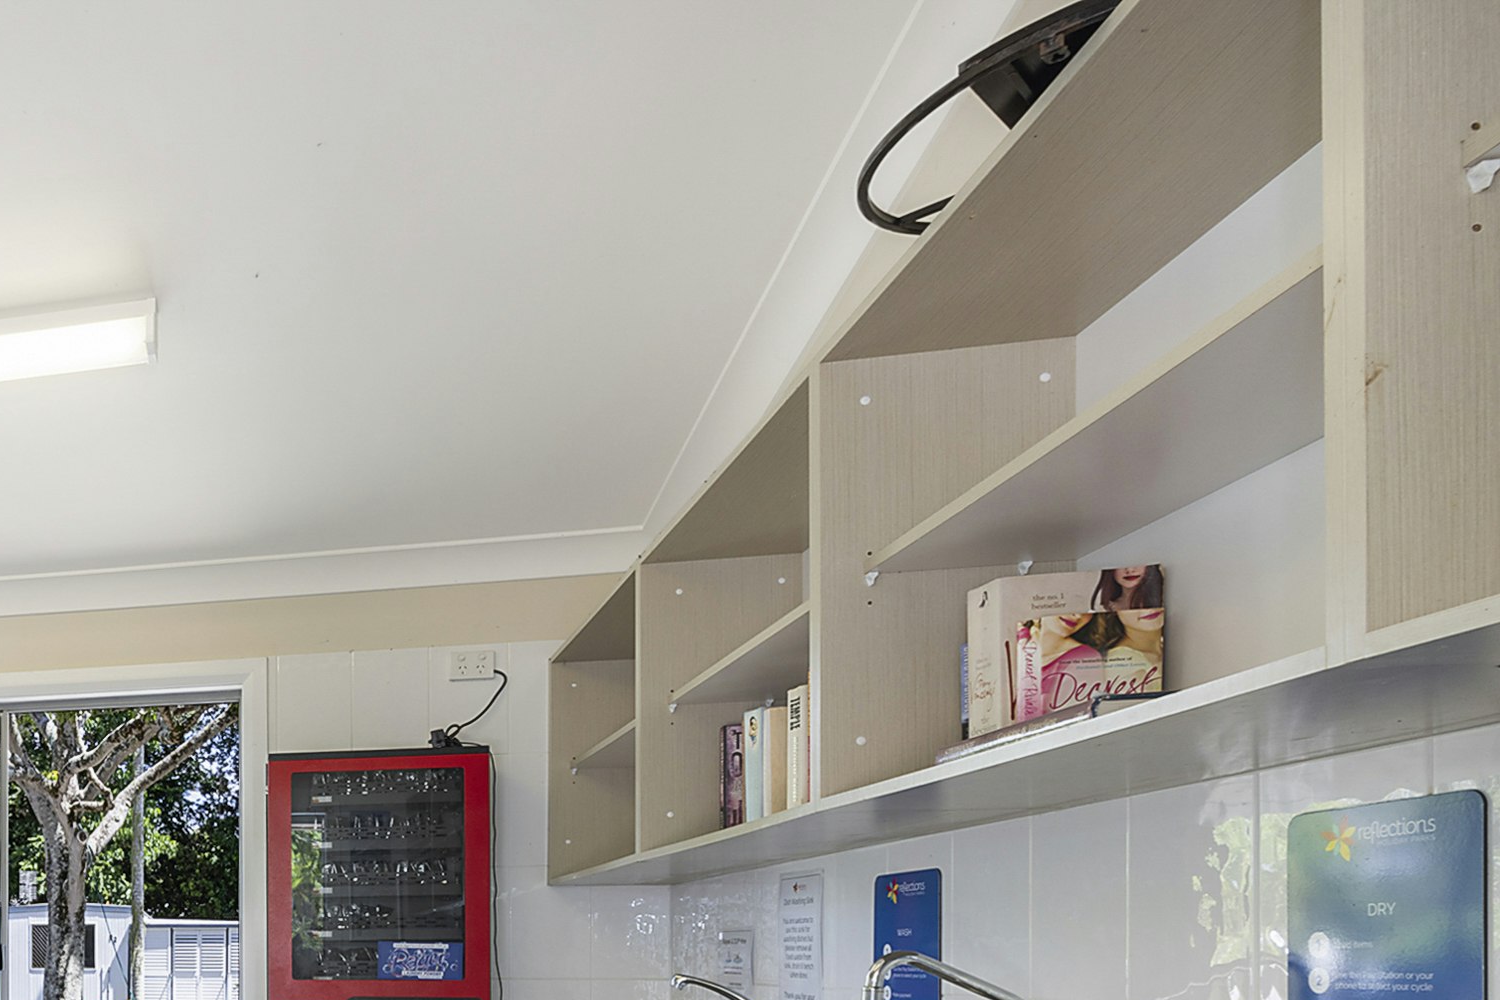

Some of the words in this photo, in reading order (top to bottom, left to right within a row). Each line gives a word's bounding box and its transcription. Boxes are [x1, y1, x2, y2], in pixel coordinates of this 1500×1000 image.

[790, 695, 801, 731] TEMPLE
[1358, 817, 1436, 844] reflections
[1367, 902, 1396, 917] DRY
[1414, 973, 1434, 982] your
[1411, 983, 1434, 993] cycle
